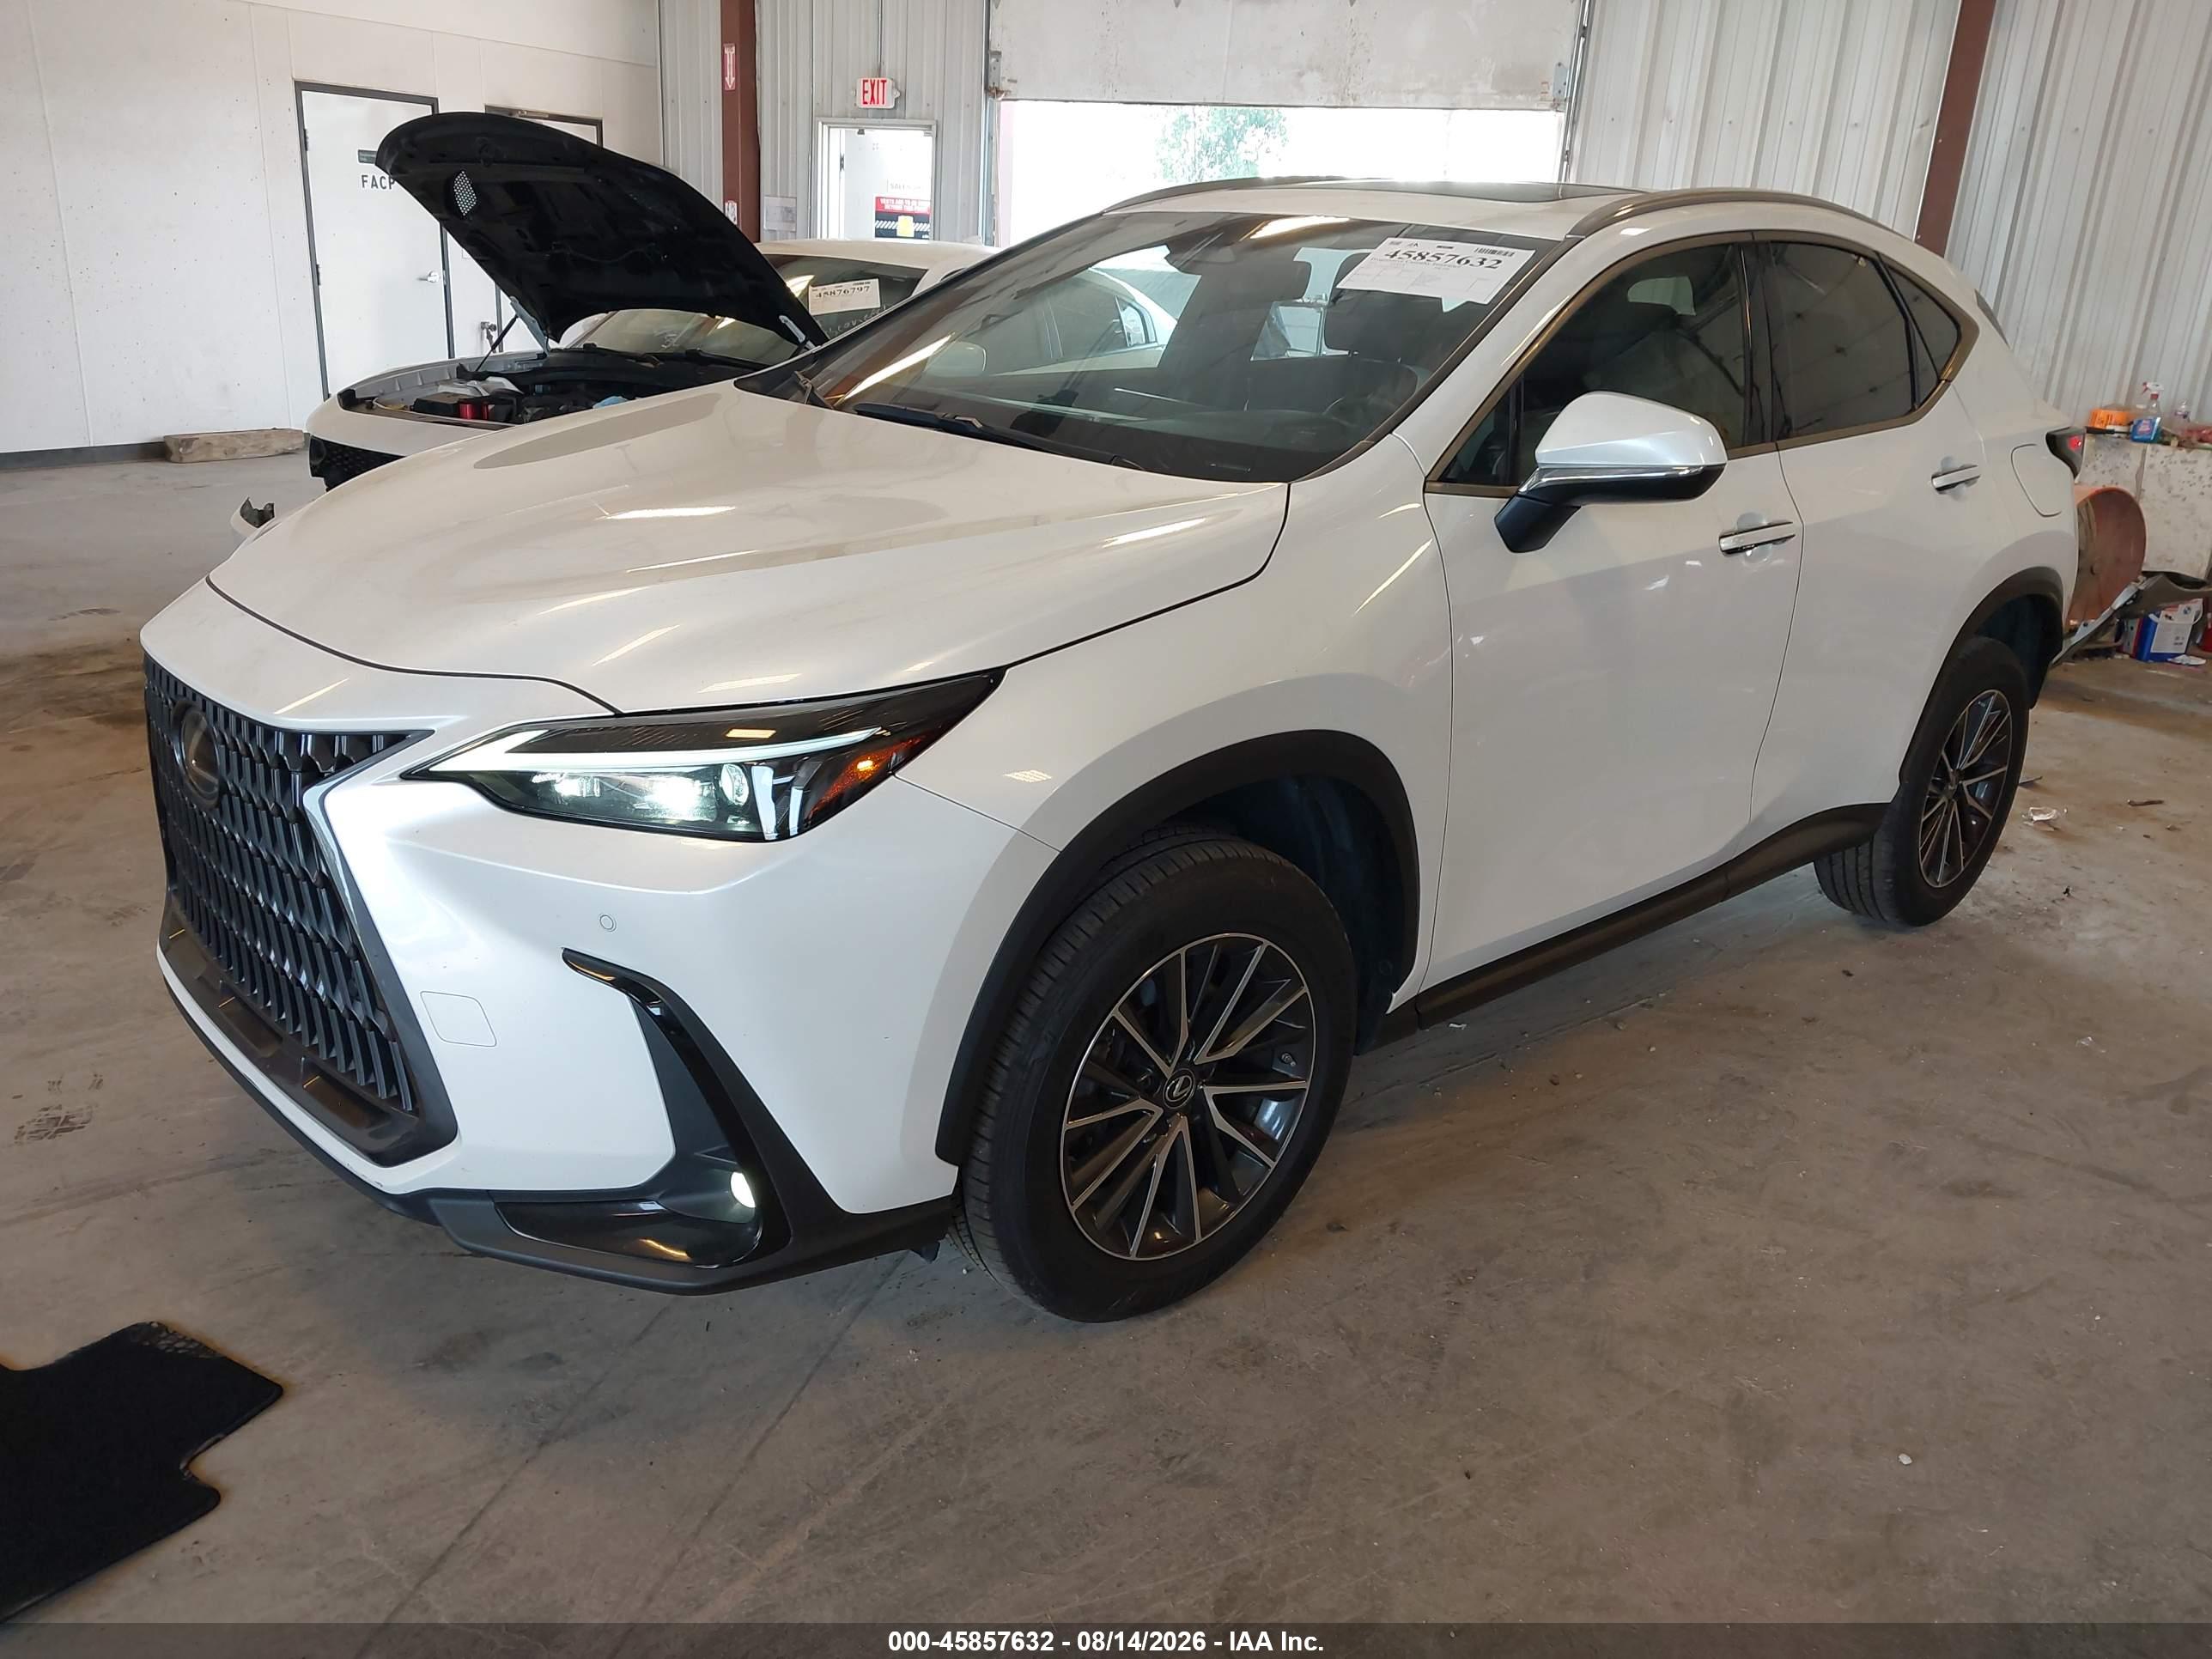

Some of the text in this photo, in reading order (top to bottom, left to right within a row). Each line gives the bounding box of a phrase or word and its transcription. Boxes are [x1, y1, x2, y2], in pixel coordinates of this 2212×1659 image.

[862, 79, 887, 105] EXIT
[361, 174, 396, 190] FACP
[1384, 249, 1503, 270] 45857632
